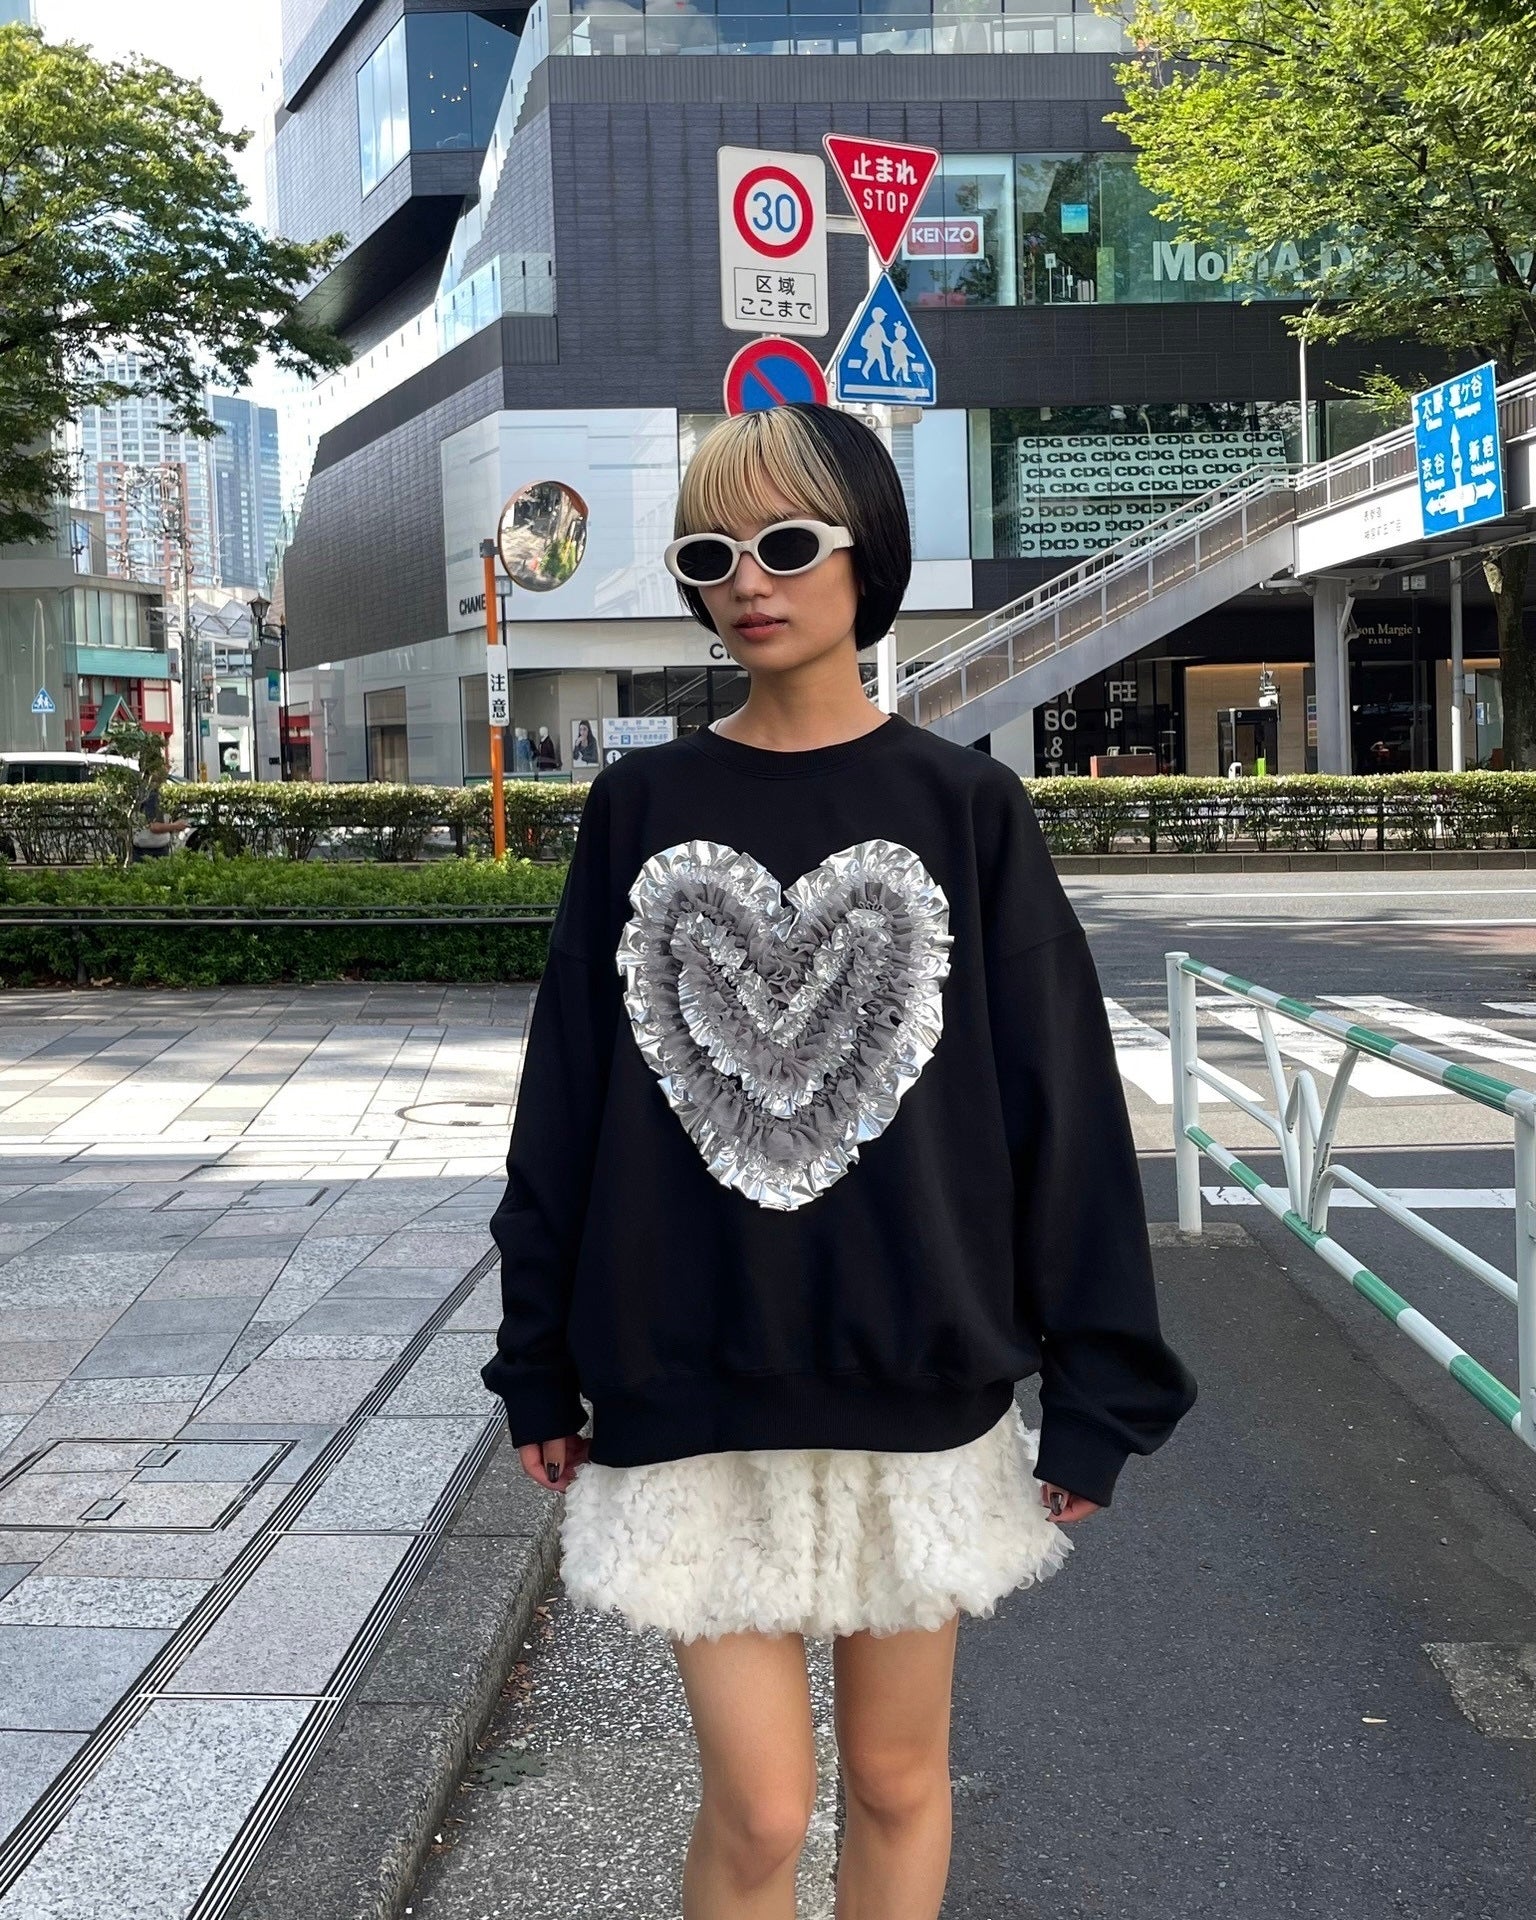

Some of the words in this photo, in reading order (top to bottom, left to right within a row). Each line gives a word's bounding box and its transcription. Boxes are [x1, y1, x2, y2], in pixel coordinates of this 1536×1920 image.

[850, 152, 918, 186] 止まれ
[863, 188, 909, 214] STOP
[752, 191, 796, 233] 30
[911, 226, 975, 243] KENZO
[756, 275, 796, 296] 区域
[741, 297, 812, 320] ここまで
[1023, 438, 1063, 448] CDG
[1067, 437, 1107, 447] CDG
[1111, 436, 1150, 446] CDG
[1155, 434, 1195, 445] CDG
[1199, 433, 1239, 443] CDG
[1243, 432, 1282, 442] CDG
[1047, 453, 1087, 463] CDG
[1091, 451, 1131, 461] CDG
[1135, 450, 1174, 460] CDG
[1179, 449, 1218, 459] CDG
[1222, 448, 1262, 458] CDG
[1026, 468, 1066, 478] CDG
[1070, 467, 1111, 477] CDG
[1114, 466, 1154, 476] CDG
[1158, 465, 1198, 475] CDG
[1202, 463, 1242, 474] CDG
[1050, 483, 1090, 493] CDG
[1094, 482, 1134, 492] CDG
[1138, 480, 1178, 491] CDG
[1039, 505, 1078, 517] CDG
[1083, 504, 1122, 516] CDG
[1126, 502, 1166, 514] CDG
[1061, 521, 1101, 533] CDG
[1105, 520, 1144, 532] CDG
[1040, 538, 1079, 550] CDG
[491, 674, 506, 718] 注意
[1050, 736, 1063, 758] &
